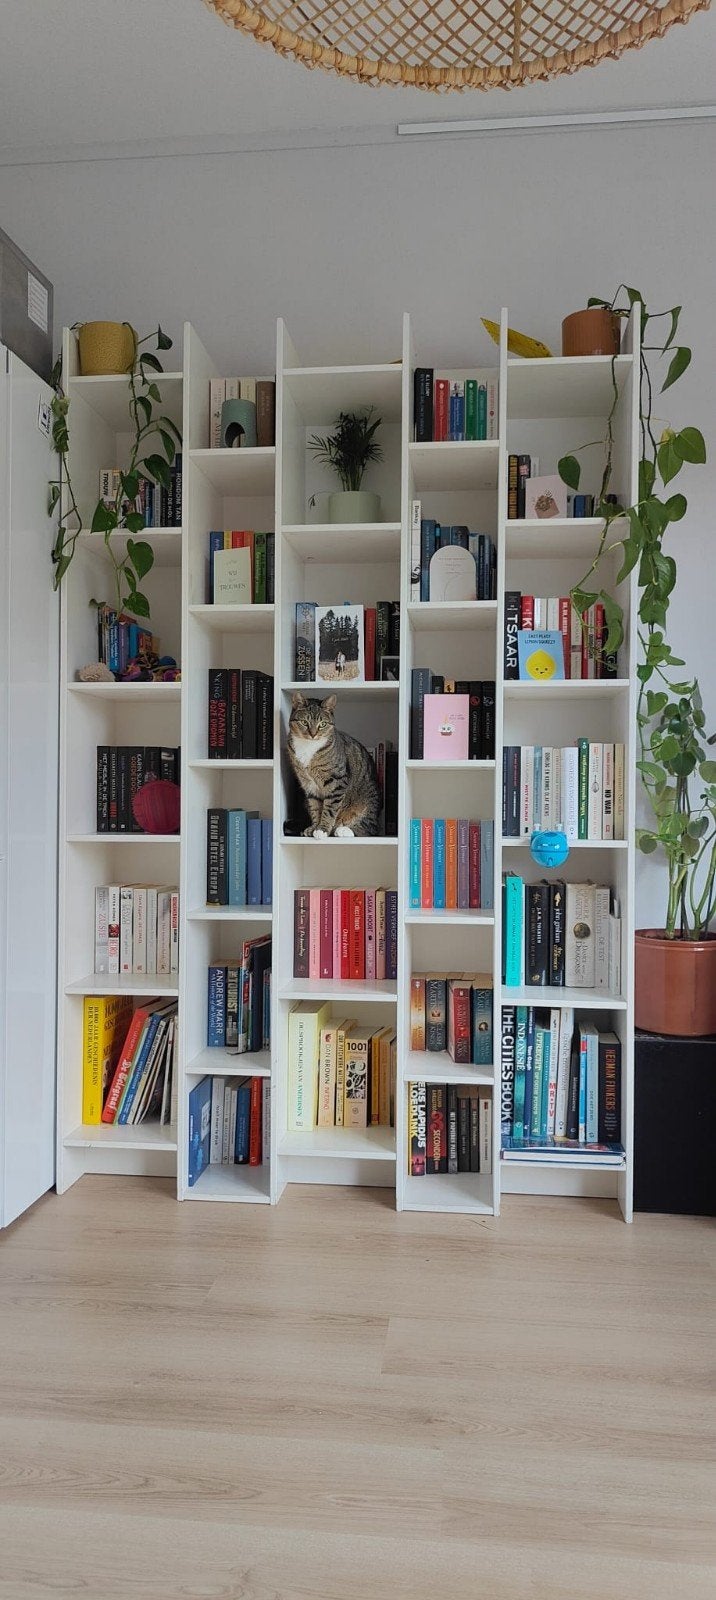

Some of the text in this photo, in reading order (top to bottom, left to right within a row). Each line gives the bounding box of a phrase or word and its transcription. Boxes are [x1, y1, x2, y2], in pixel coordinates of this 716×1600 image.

[506, 614, 518, 667] TSAAR
[102, 794, 108, 802] DE
[604, 789, 612, 798] NO
[210, 816, 219, 895] GRAND HOTEL EUROPA
[552, 921, 562, 944] grisham
[216, 970, 224, 1034] ANDREW MARR
[228, 979, 238, 1014] TOURIST
[346, 1042, 367, 1051] 1001
[502, 1008, 514, 1122] THE CITIES BOOK
[516, 1022, 526, 1070] INDONESIË
[535, 1032, 544, 1071] UTRECHT
[107, 1059, 132, 1110] De Telegraaf
[605, 1050, 616, 1110] HERMAN FINKERS
[433, 1130, 441, 1160] SECONDEN
